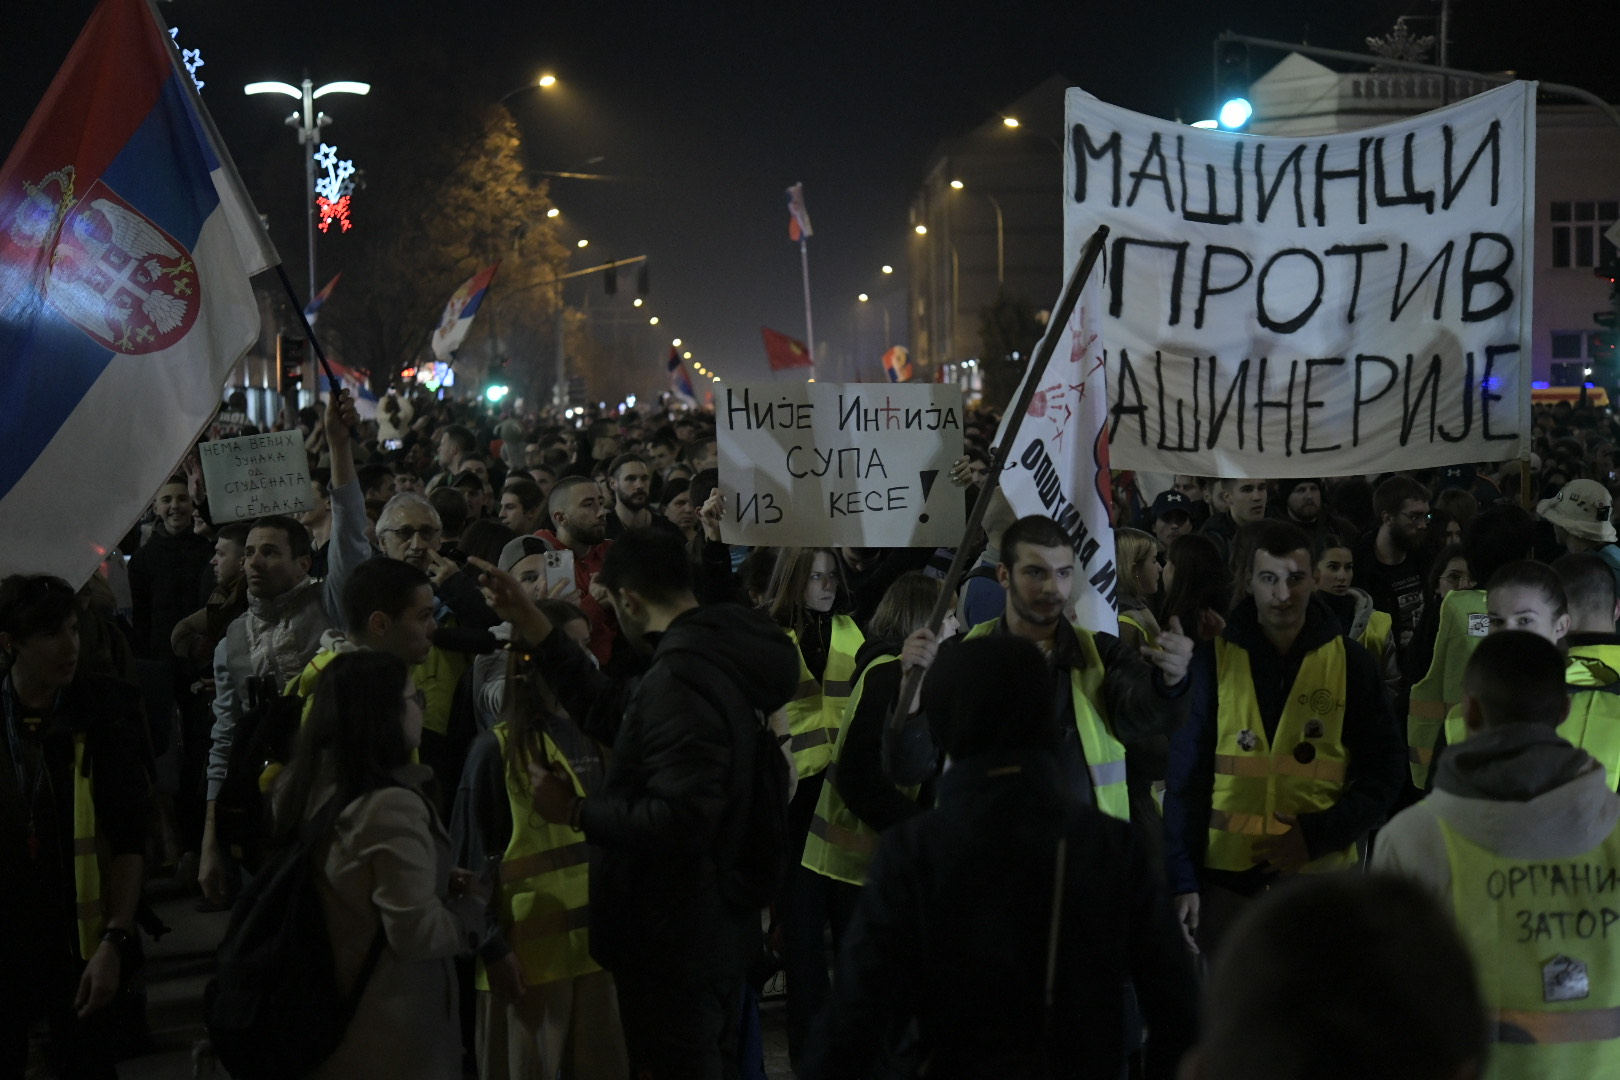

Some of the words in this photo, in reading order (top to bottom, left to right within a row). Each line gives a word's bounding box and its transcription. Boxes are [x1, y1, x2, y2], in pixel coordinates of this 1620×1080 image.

[1072, 119, 1500, 227] МАШИНЦИ
[1109, 232, 1515, 334] ПРОТИВ
[1105, 344, 1521, 458] АШИНЕРИЈЕ
[204, 442, 241, 456] НЕМА
[786, 445, 888, 480] СУПА
[224, 473, 305, 494] СТУДЕНАТА
[235, 497, 304, 518] СЕЉАКА
[736, 491, 784, 525] ИЗ
[1516, 907, 1620, 944] ЗАТОР
